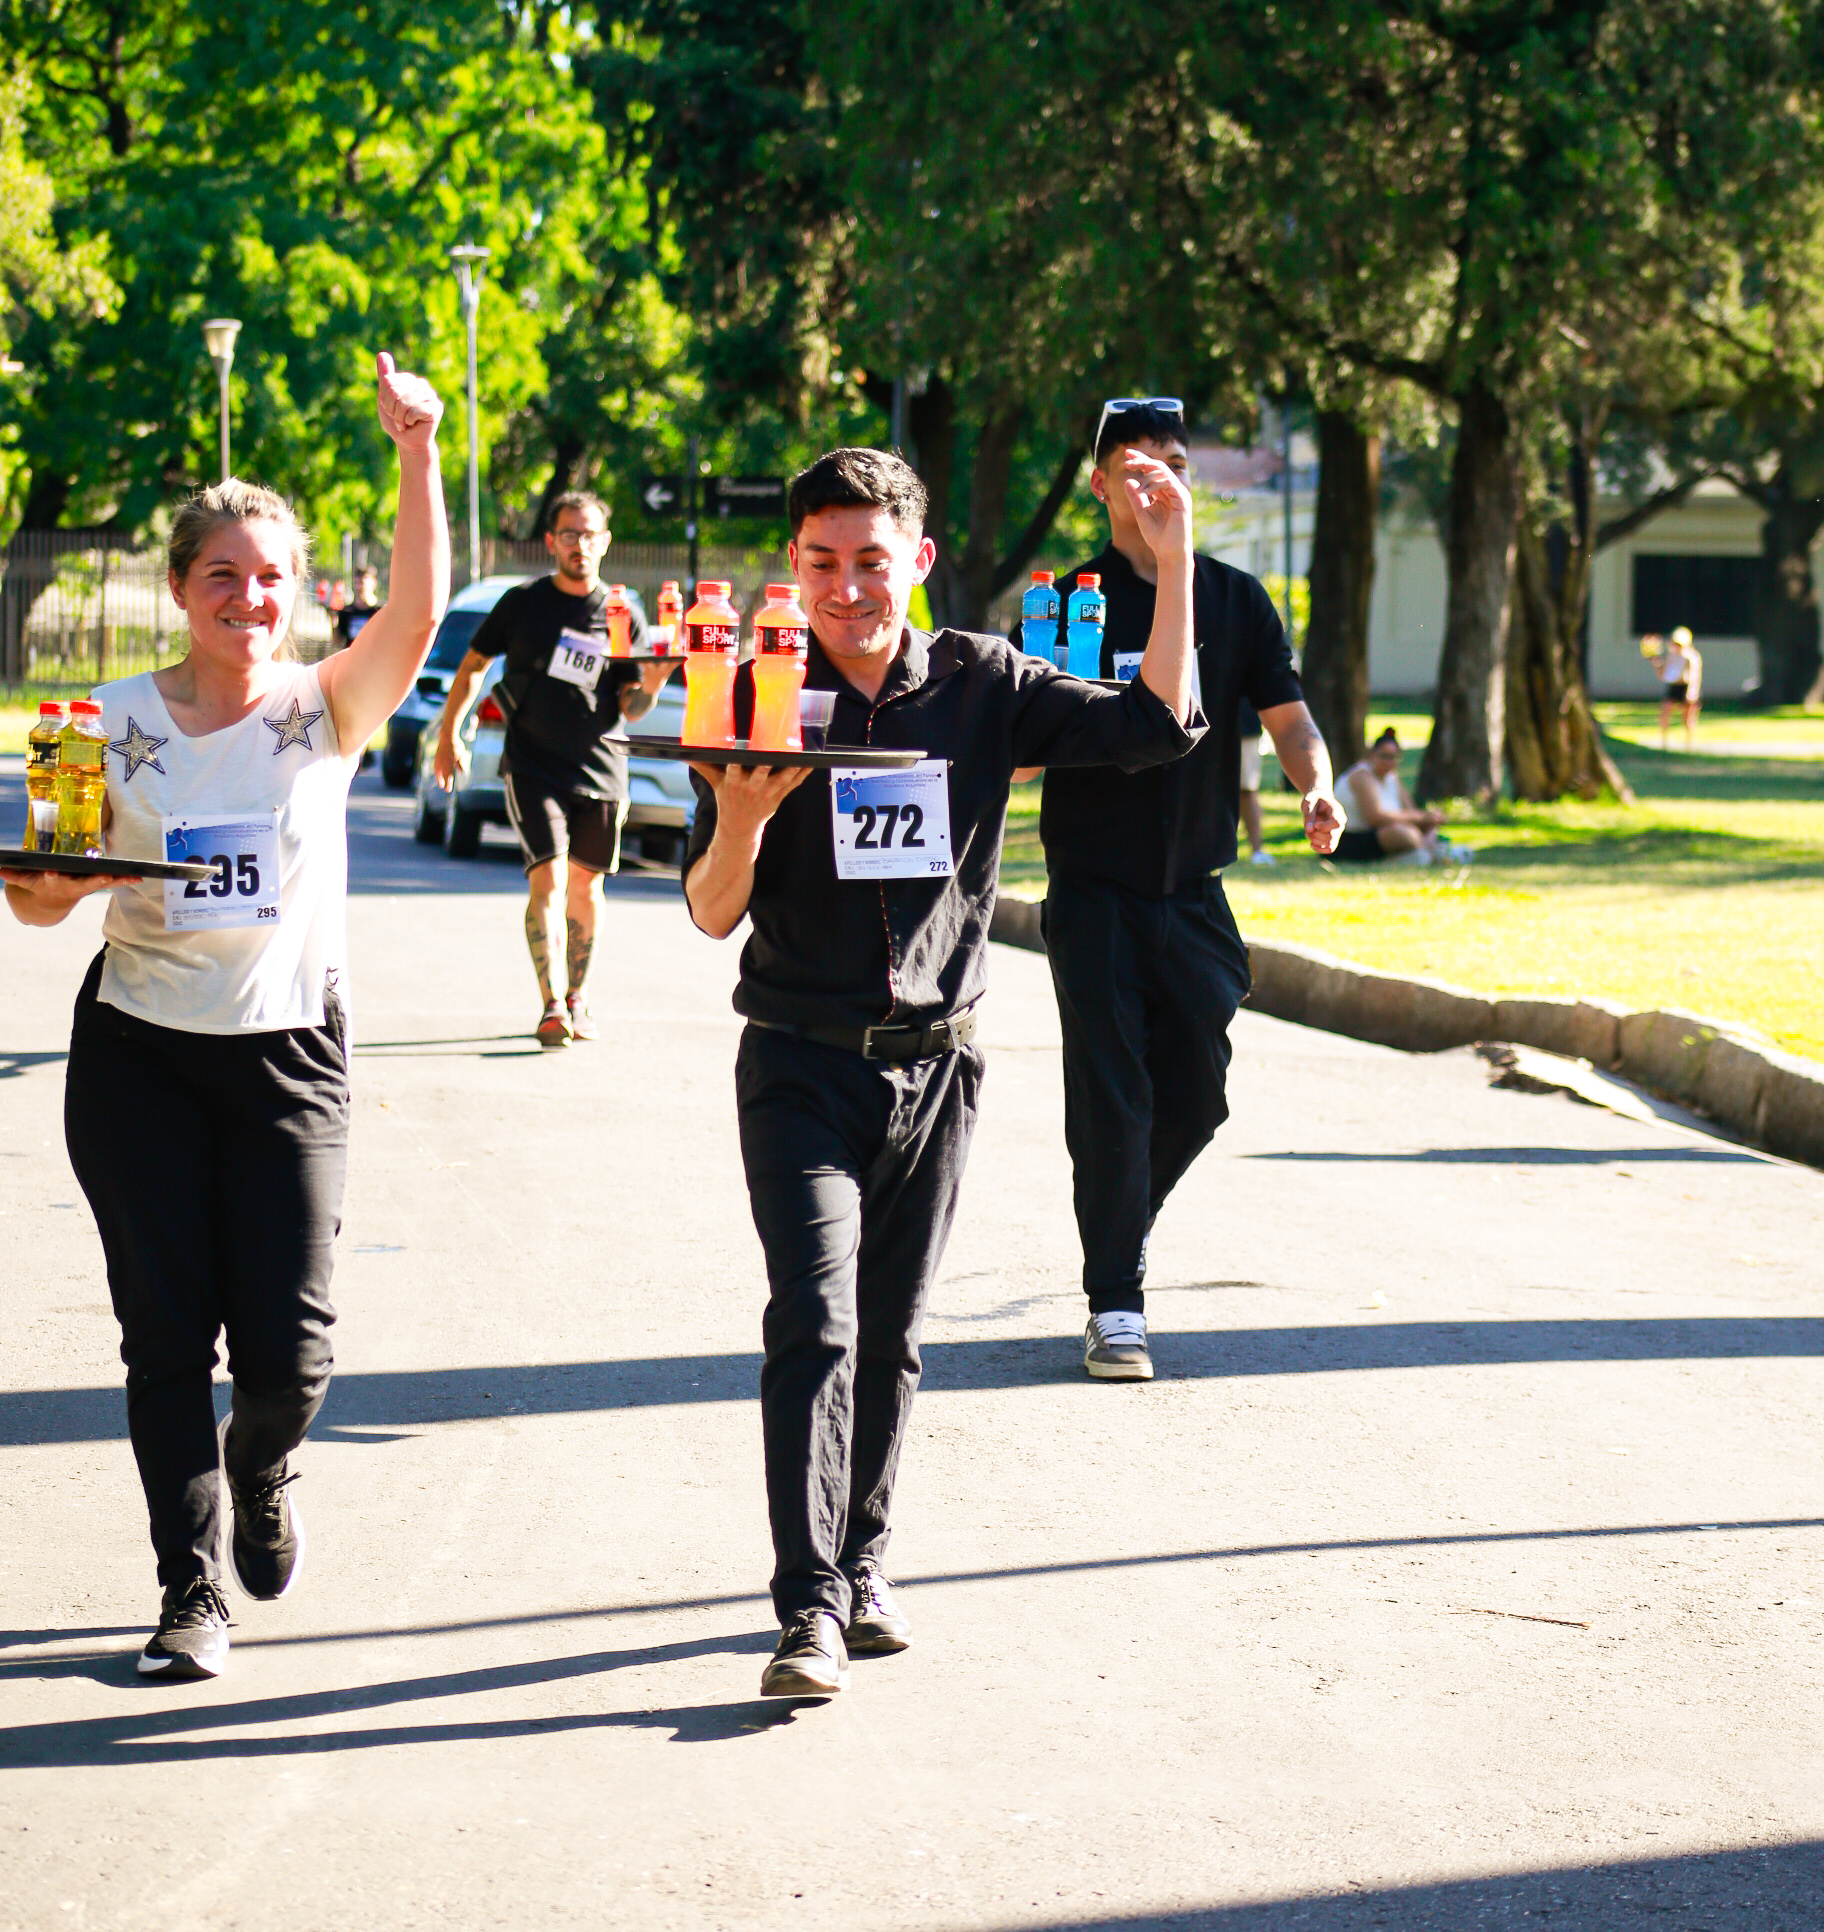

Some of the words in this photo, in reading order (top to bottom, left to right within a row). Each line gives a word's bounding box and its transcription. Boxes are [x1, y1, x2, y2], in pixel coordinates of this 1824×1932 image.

[702, 626, 729, 636] FULL
[778, 629, 801, 638] FULL
[702, 634, 736, 645] SPORT
[563, 647, 597, 673] 168
[853, 804, 926, 849] 272
[929, 861, 949, 872] 272
[183, 854, 260, 898] 295
[257, 907, 278, 918] 295
